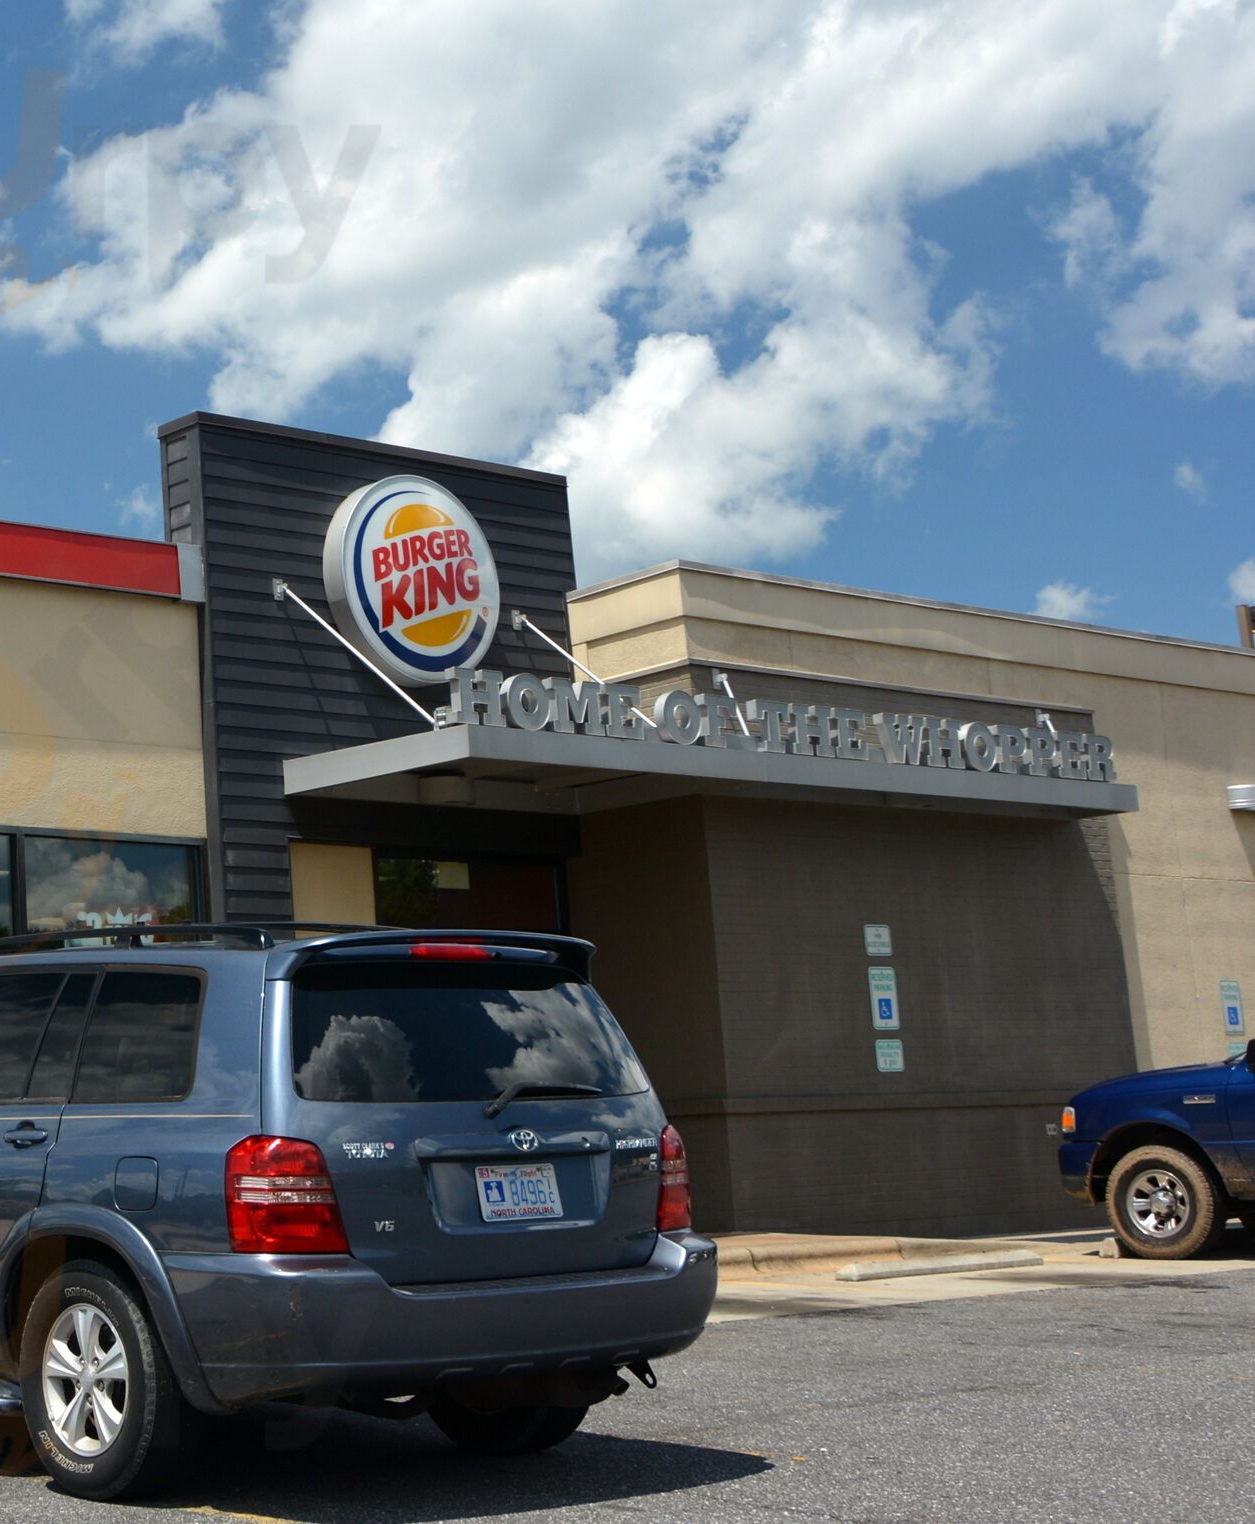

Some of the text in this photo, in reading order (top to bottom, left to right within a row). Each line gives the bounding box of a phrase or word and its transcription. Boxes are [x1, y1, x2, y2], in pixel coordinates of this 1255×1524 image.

[371, 528, 473, 583] BURGER
[380, 557, 481, 630] KING
[445, 666, 1117, 782] HOME OF THE WHOPPER
[490, 1205, 555, 1217] NORTH CAROLINA
[509, 1178, 547, 1206] 8496
[374, 1220, 395, 1232] V6
[38, 1429, 95, 1474] MICHELIN
